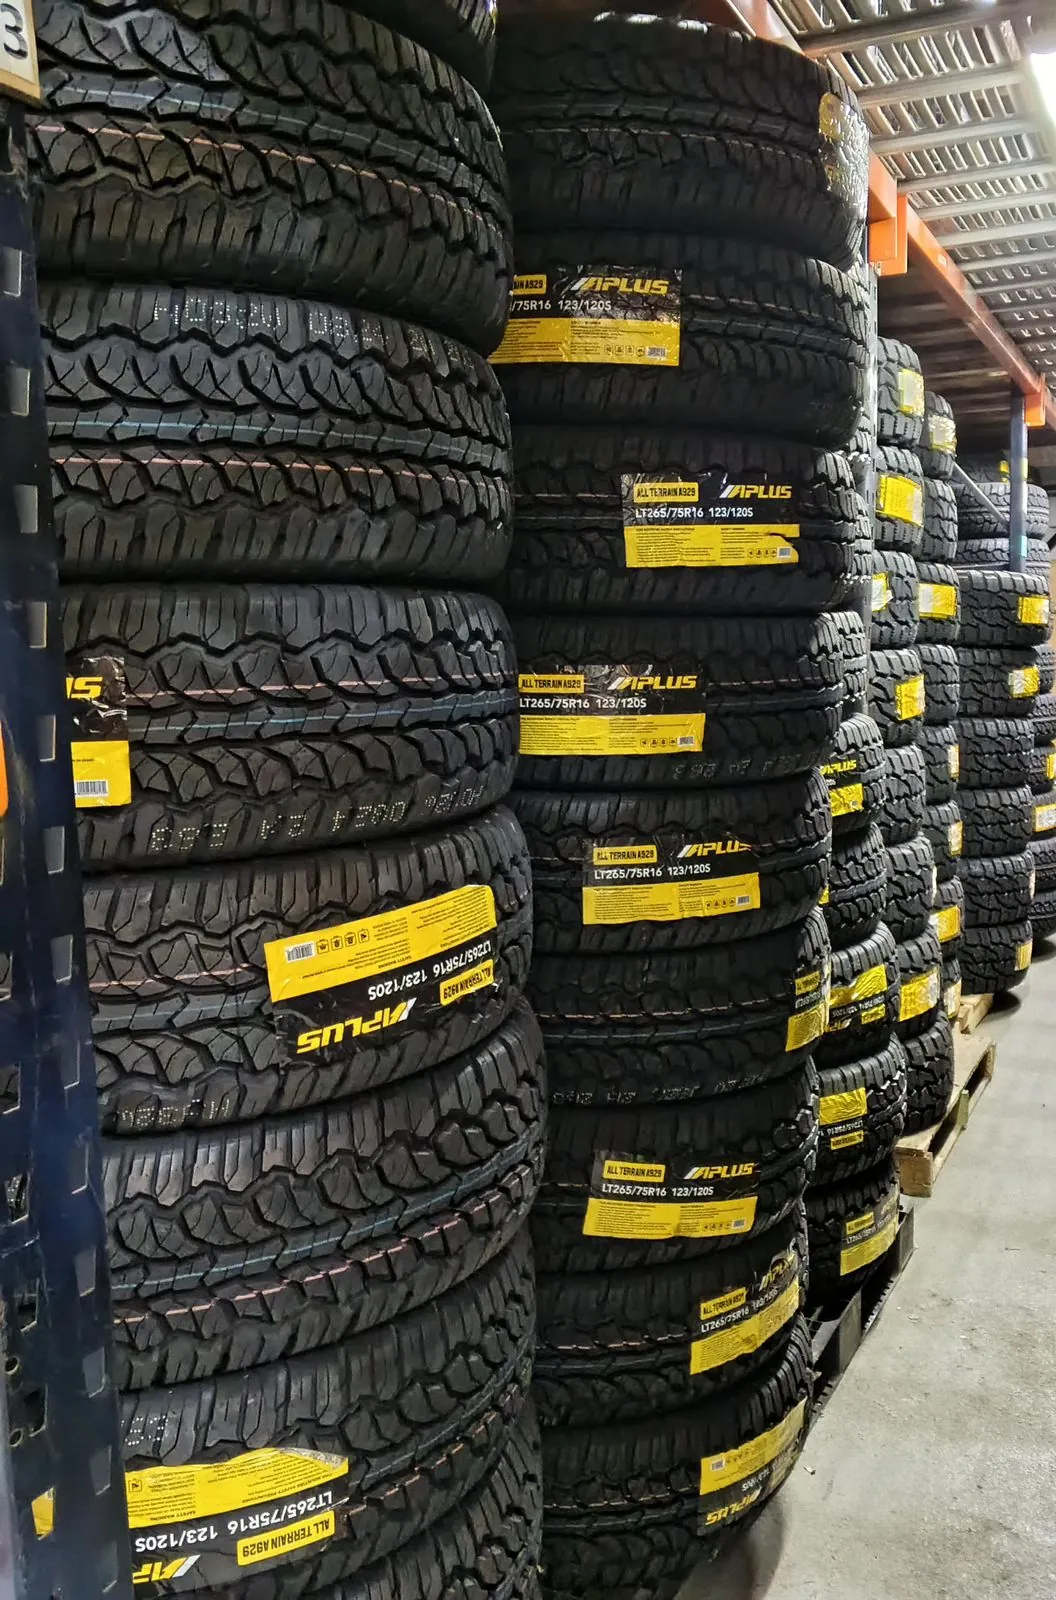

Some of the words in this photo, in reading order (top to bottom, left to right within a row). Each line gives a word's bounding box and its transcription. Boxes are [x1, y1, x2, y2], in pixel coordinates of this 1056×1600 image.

[571, 277, 669, 295] APLUS
[510, 299, 552, 311] /75R16
[558, 300, 612, 311] 123/120S
[636, 487, 649, 498] ALL
[650, 486, 678, 498] TERRAIN
[719, 485, 792, 499] APLUS
[635, 507, 704, 519] LT265/75R16
[709, 507, 754, 518] 123/120S
[521, 679, 534, 688] ALL
[534, 679, 562, 688] TERRAIN
[608, 675, 698, 691] APLUS
[519, 698, 590, 709] LT265/75R16
[597, 697, 647, 709] 123/120S
[608, 849, 637, 860] TERRAIN
[594, 868, 663, 880] LT265/75R16
[668, 864, 711, 877] 123/120S
[433, 939, 491, 978] LT265/75R16
[368, 969, 428, 1001] 123/120S
[297, 997, 417, 1054] APLUS
[606, 1165, 618, 1176] ALL
[618, 1166, 646, 1177] TERRAIN
[684, 1162, 754, 1180] APLUS
[601, 1184, 667, 1197] LT265/75R16
[672, 1186, 714, 1197] 123/120S
[227, 1491, 333, 1535] LT265/75R16
[314, 1518, 330, 1535] ALL
[135, 1525, 218, 1553] 123/120S
[270, 1523, 313, 1549] TERRAIN
[242, 1540, 270, 1558] A929
